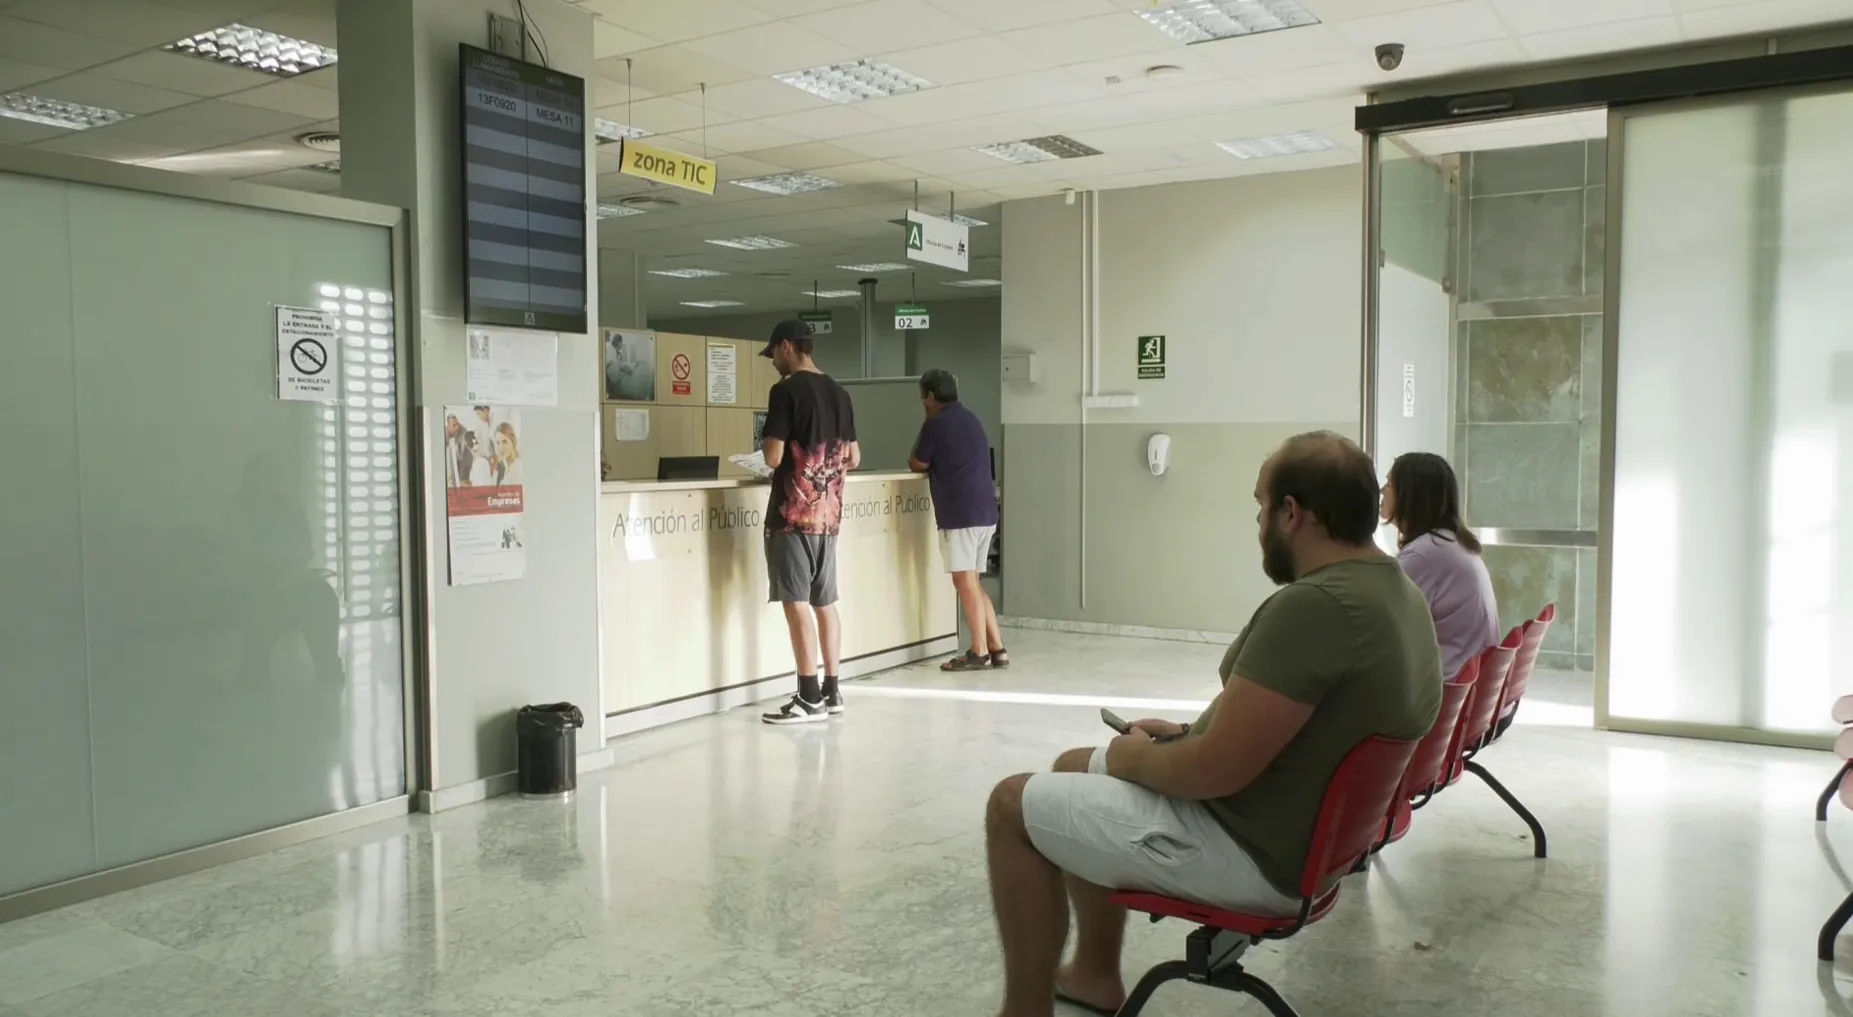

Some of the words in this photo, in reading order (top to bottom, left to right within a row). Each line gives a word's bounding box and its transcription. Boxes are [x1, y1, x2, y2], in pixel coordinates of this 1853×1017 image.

[478, 94, 516, 112] 13F0920
[536, 108, 562, 125] MESA
[565, 115, 573, 126] 11
[633, 152, 676, 178] zona
[681, 160, 708, 185] TIC
[898, 317, 912, 329] 02
[487, 496, 521, 507] Empresas
[884, 495, 893, 516] al
[895, 491, 931, 515] Público
[612, 507, 687, 539] Atención
[692, 508, 704, 532] al
[709, 503, 761, 532] Público
